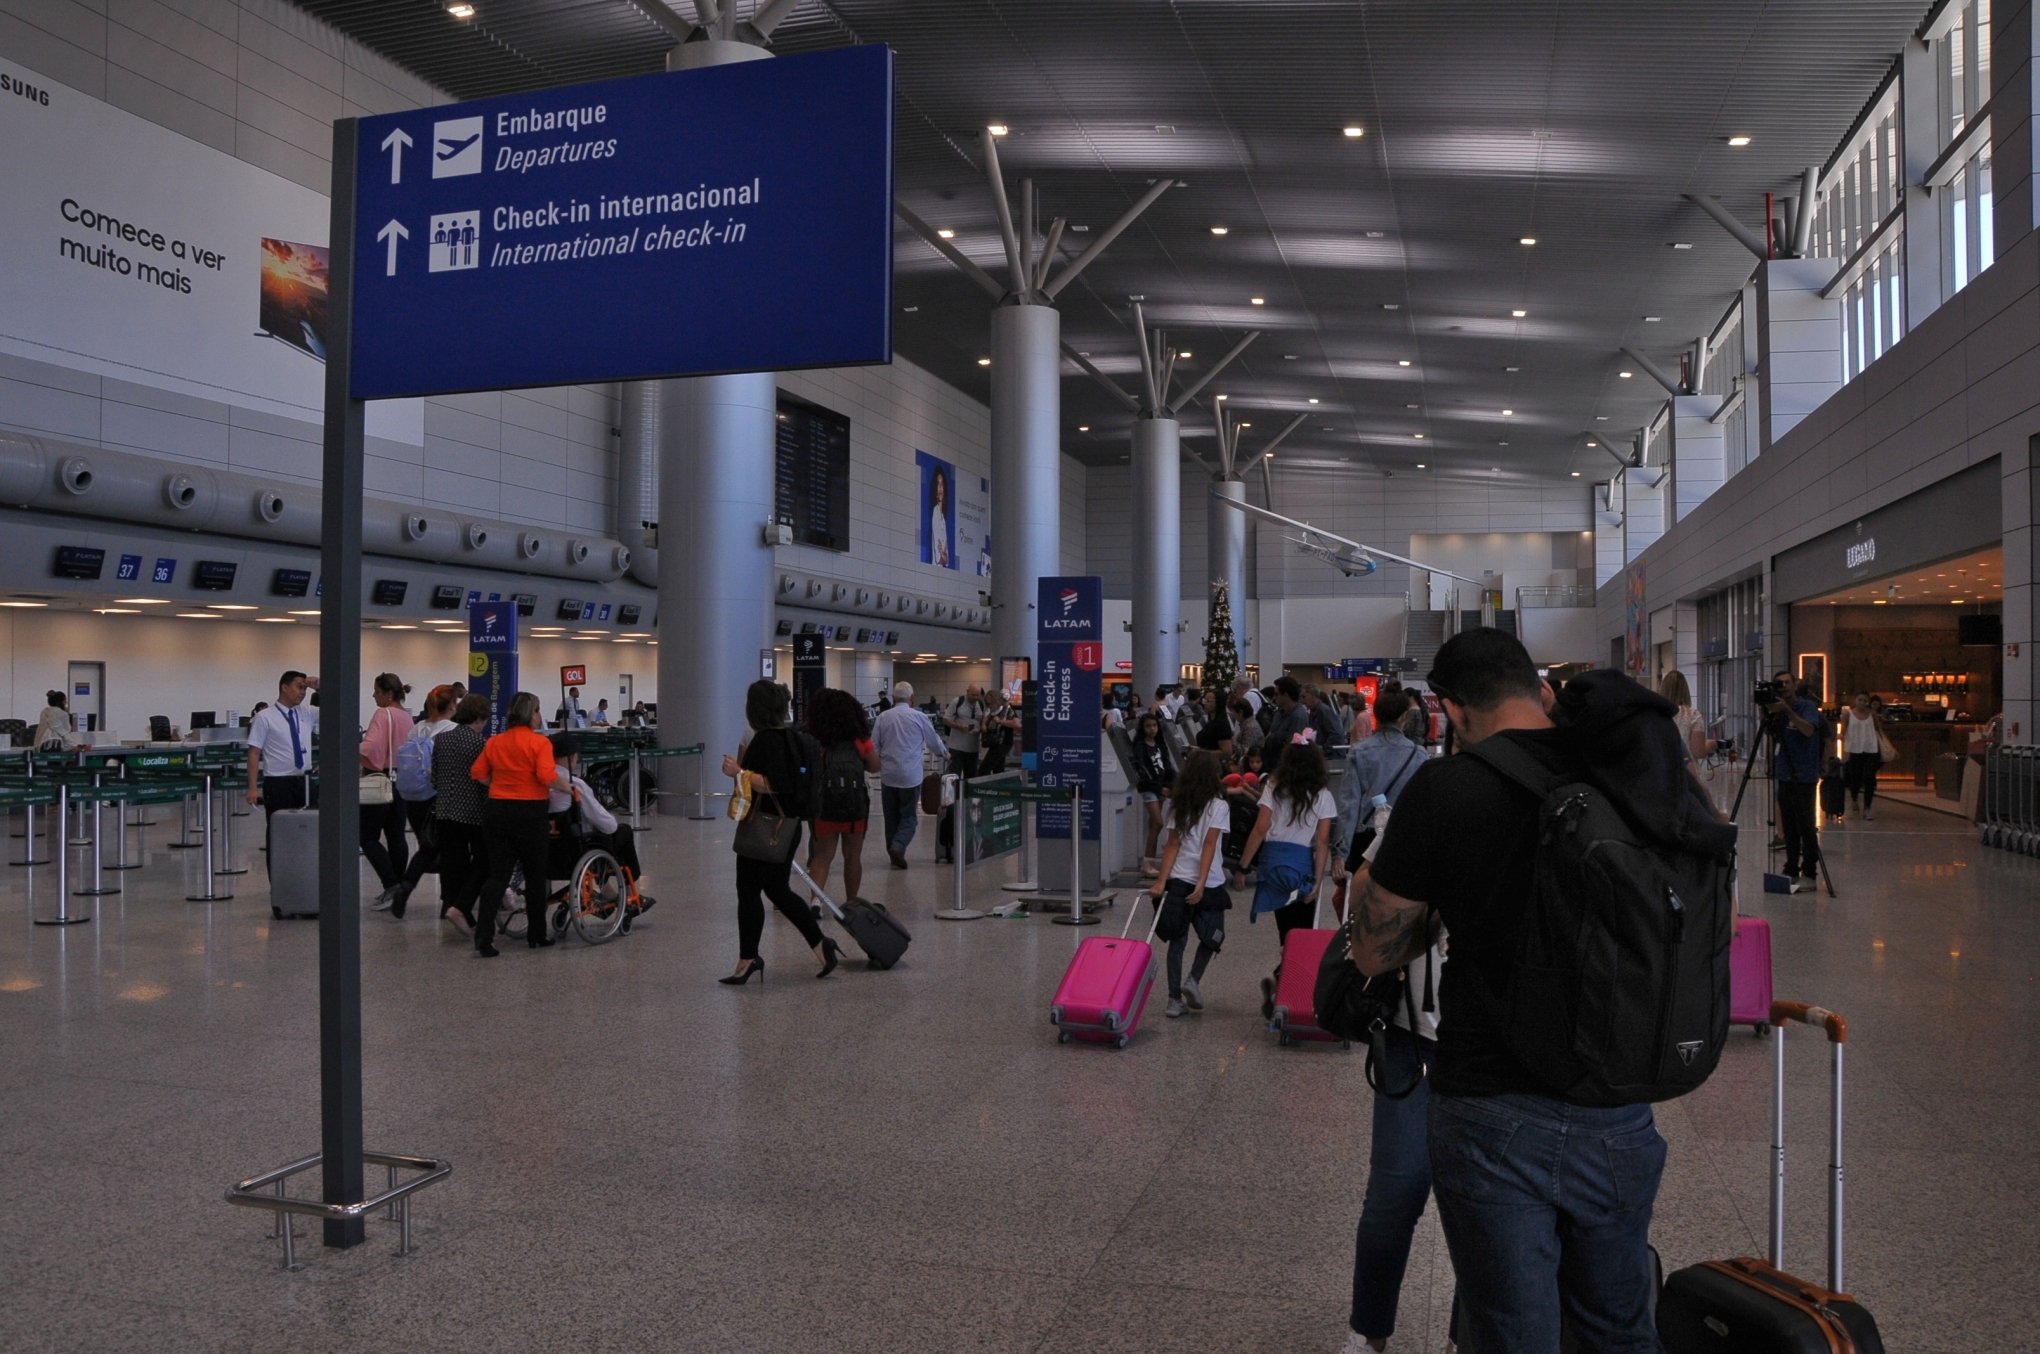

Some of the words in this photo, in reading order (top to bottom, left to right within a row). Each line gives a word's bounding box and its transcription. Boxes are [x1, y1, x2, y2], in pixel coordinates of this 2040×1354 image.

[0, 74, 49, 107] SUNG
[496, 103, 607, 138] Embarque
[494, 134, 617, 174] Departures
[492, 192, 591, 232] Check-in
[599, 178, 760, 221] internacional
[60, 197, 166, 251] Comece
[171, 238, 186, 260] a
[191, 246, 226, 272] ver
[490, 226, 639, 268] International
[643, 217, 747, 252] check-in
[60, 234, 132, 277] muito
[137, 260, 192, 295] mais
[119, 564, 134, 578] 37
[154, 567, 169, 581] 36
[473, 635, 506, 643] LATAM
[1043, 619, 1092, 629] LATAM
[476, 657, 485, 672] 2
[1083, 646, 1096, 666] 1
[490, 661, 501, 700] Bagagem
[566, 669, 583, 681] GOL
[1043, 660, 1057, 721] Check-in
[1058, 667, 1074, 721] Express
[491, 715, 500, 737] trega
[143, 756, 169, 766] Localiza
